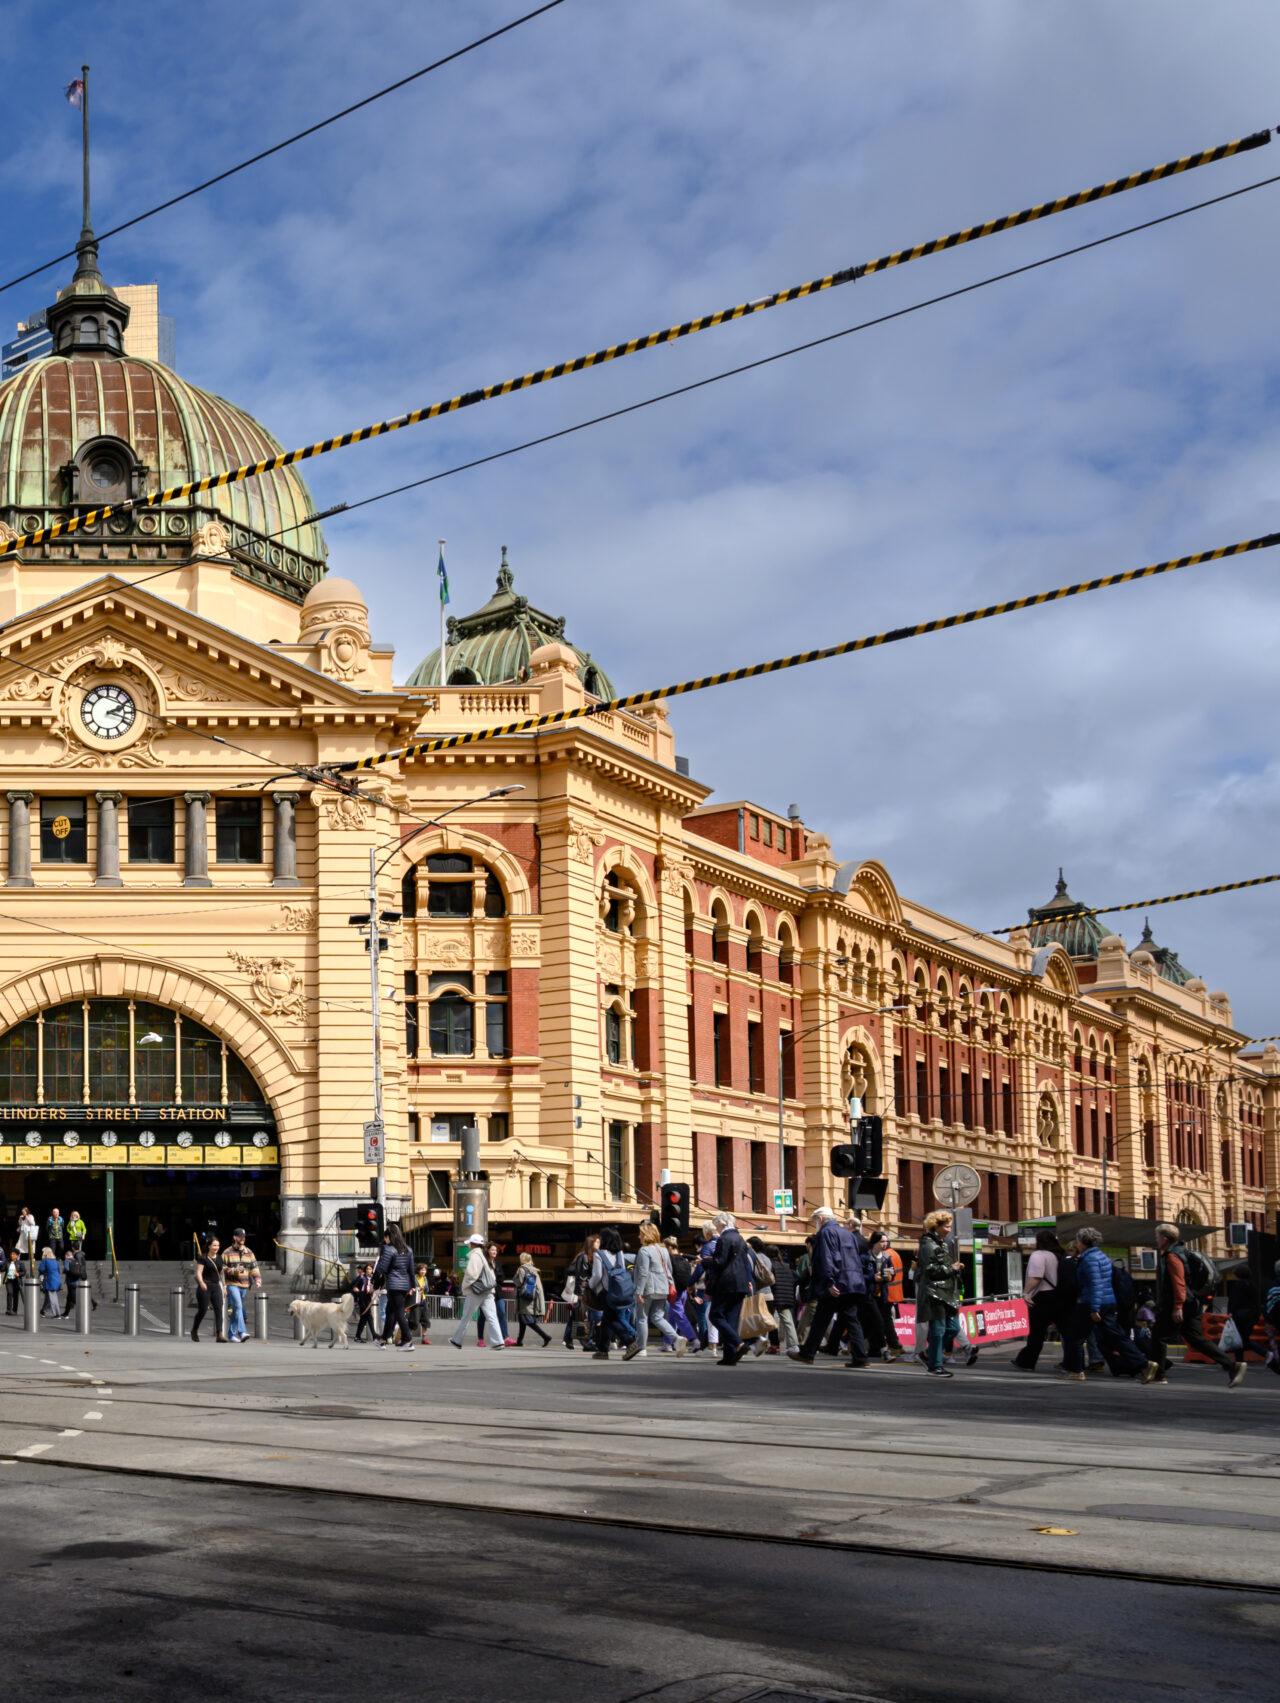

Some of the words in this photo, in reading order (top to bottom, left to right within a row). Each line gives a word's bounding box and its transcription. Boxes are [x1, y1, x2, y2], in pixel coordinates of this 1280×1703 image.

[54, 819, 67, 827] CUT
[55, 828, 68, 836] OFF
[85, 1108, 141, 1120] STREET
[159, 1108, 226, 1120] STATION
